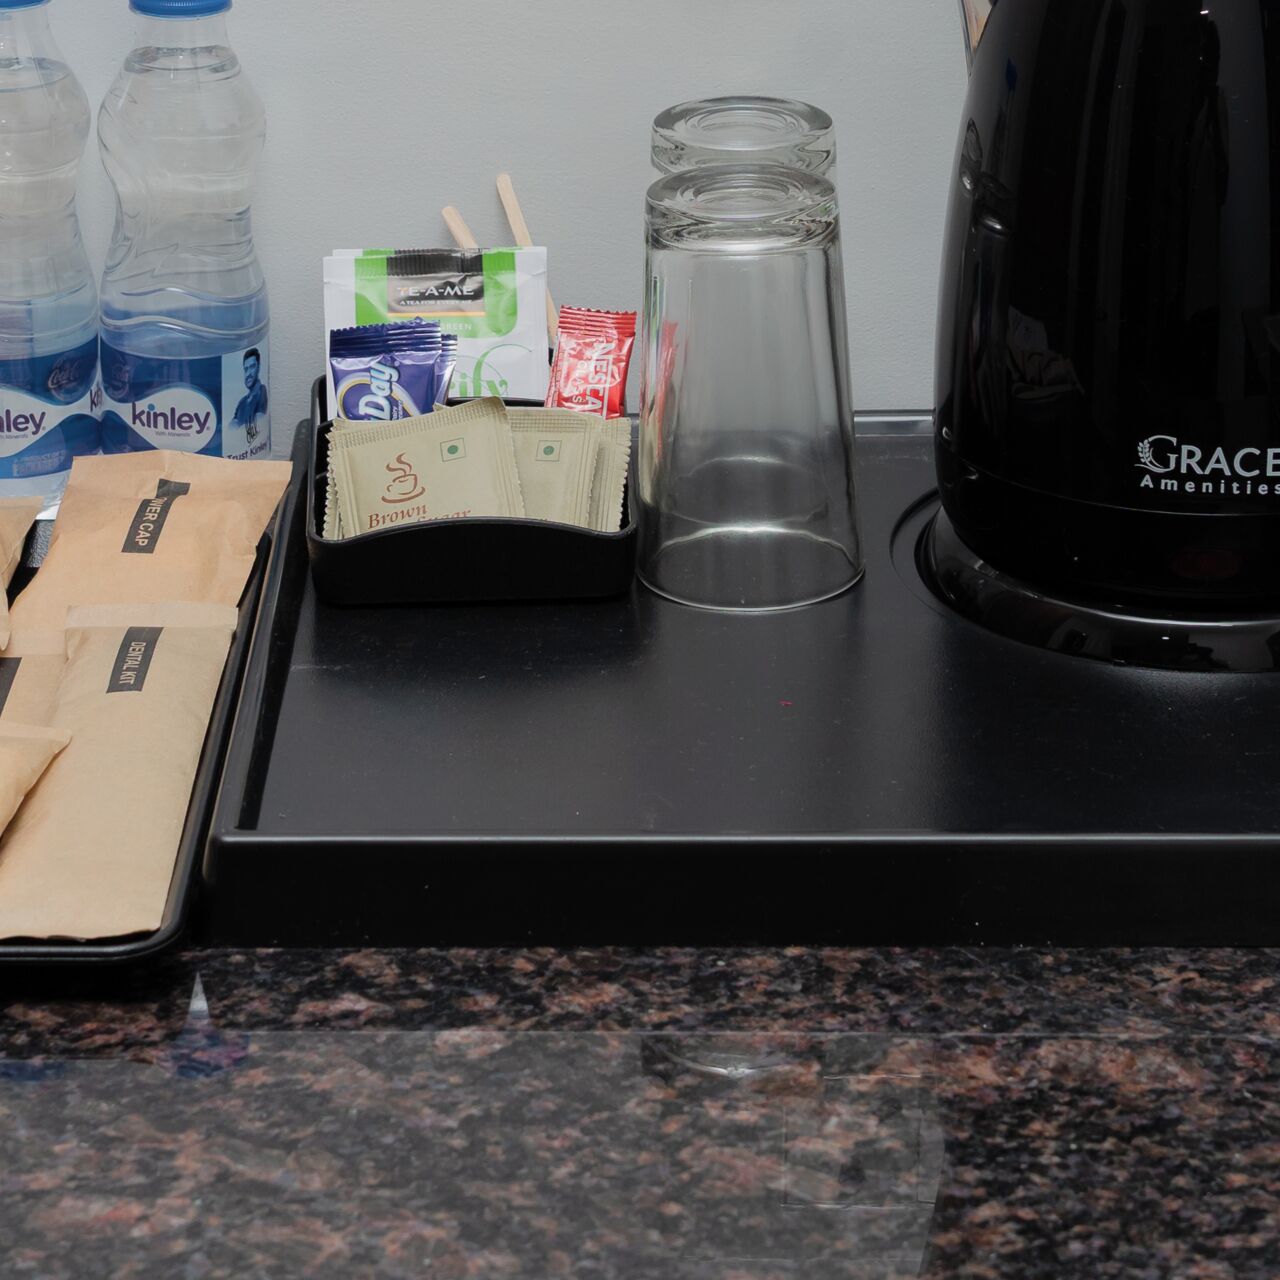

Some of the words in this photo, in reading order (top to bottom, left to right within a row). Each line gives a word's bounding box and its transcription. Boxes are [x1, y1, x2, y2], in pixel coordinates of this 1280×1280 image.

[397, 285, 474, 297] TE-A-ME
[586, 342, 615, 414] NESCA
[131, 401, 211, 435] kinley
[368, 505, 428, 529] Brown
[135, 522, 154, 546] CAP
[122, 641, 147, 670] DENTAL
[119, 671, 137, 685] KIT
